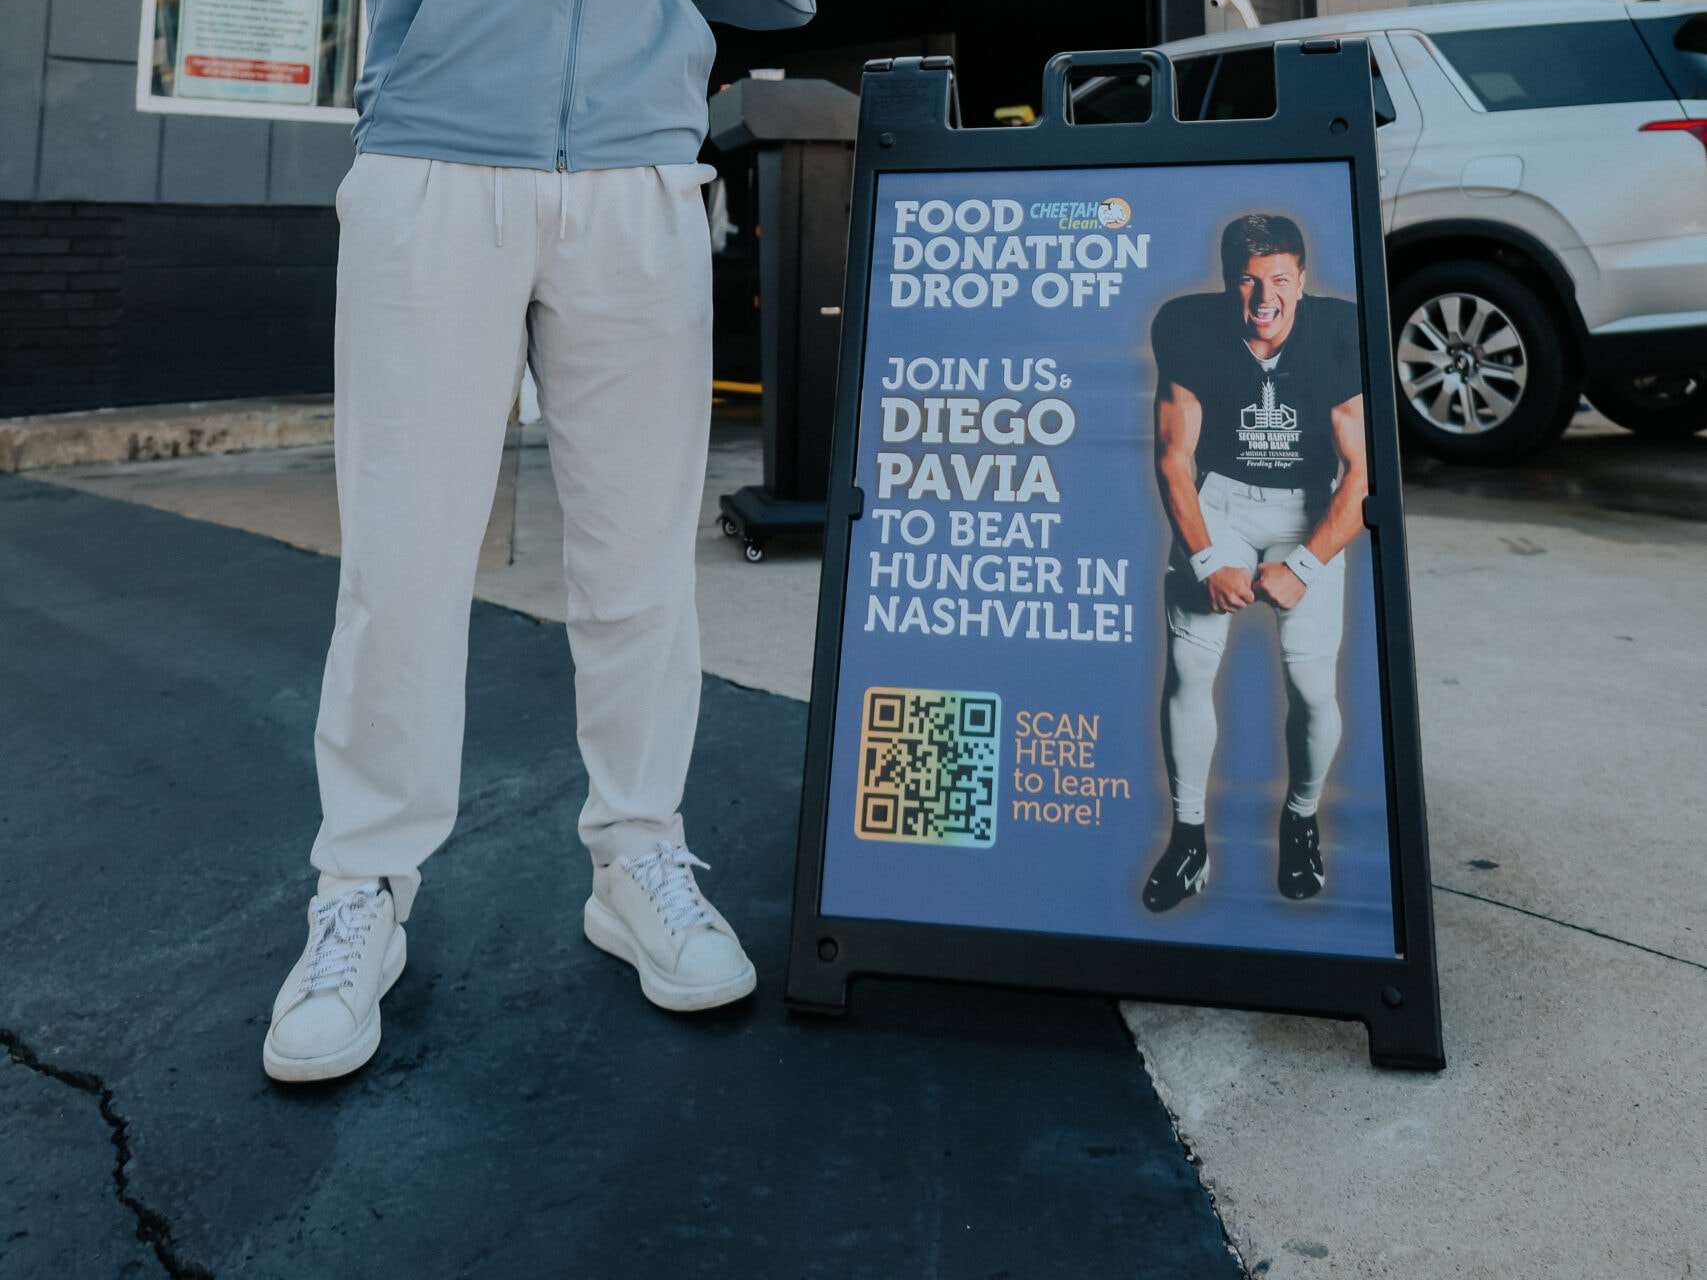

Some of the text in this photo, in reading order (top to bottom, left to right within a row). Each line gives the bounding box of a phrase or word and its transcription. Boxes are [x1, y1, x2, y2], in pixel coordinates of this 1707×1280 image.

[894, 199, 1024, 233] FOOD
[1030, 201, 1099, 219] CHEETAH
[1059, 217, 1098, 230] Clean
[892, 233, 1151, 270] DONATION
[890, 272, 1123, 308] DROP OFF
[882, 357, 989, 391] JOIN
[881, 397, 1076, 446] DIEGO
[1238, 432, 1299, 442] SECOND HARVEST
[1248, 441, 1290, 450] FOOD BANK
[877, 453, 1061, 503] PAVIA
[1247, 460, 1273, 469] Feeding
[872, 508, 1061, 549] TO BEAT
[869, 551, 1129, 596] HUNGER IN
[864, 595, 1133, 643] NASHVILLE!
[1016, 711, 1100, 740] SCAN
[1015, 738, 1096, 768] HERE
[1013, 768, 1131, 799] to learn
[1013, 799, 1101, 825] more!
